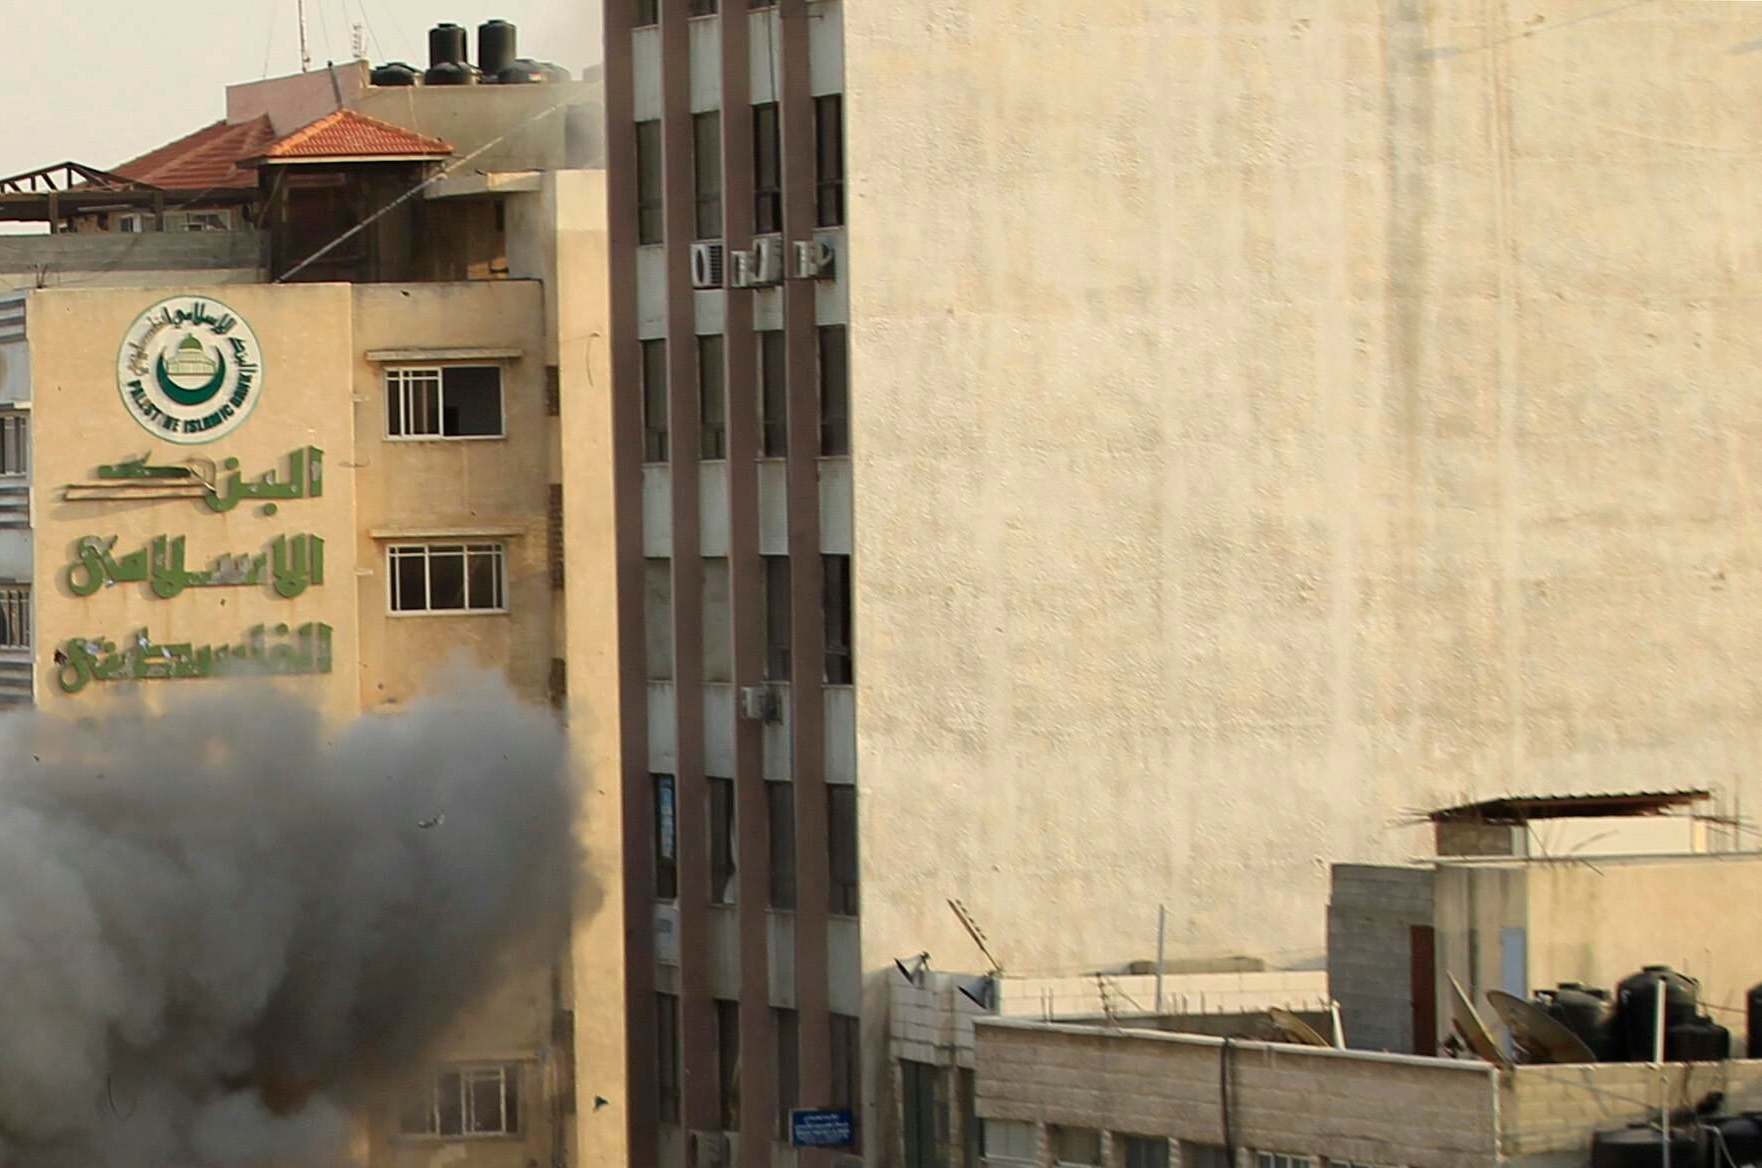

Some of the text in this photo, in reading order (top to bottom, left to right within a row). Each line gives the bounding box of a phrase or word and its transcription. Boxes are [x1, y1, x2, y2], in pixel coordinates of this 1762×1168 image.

[183, 403, 235, 433] ISLAMIC
[228, 373, 253, 409] BANK
[63, 444, 325, 515] البنك
